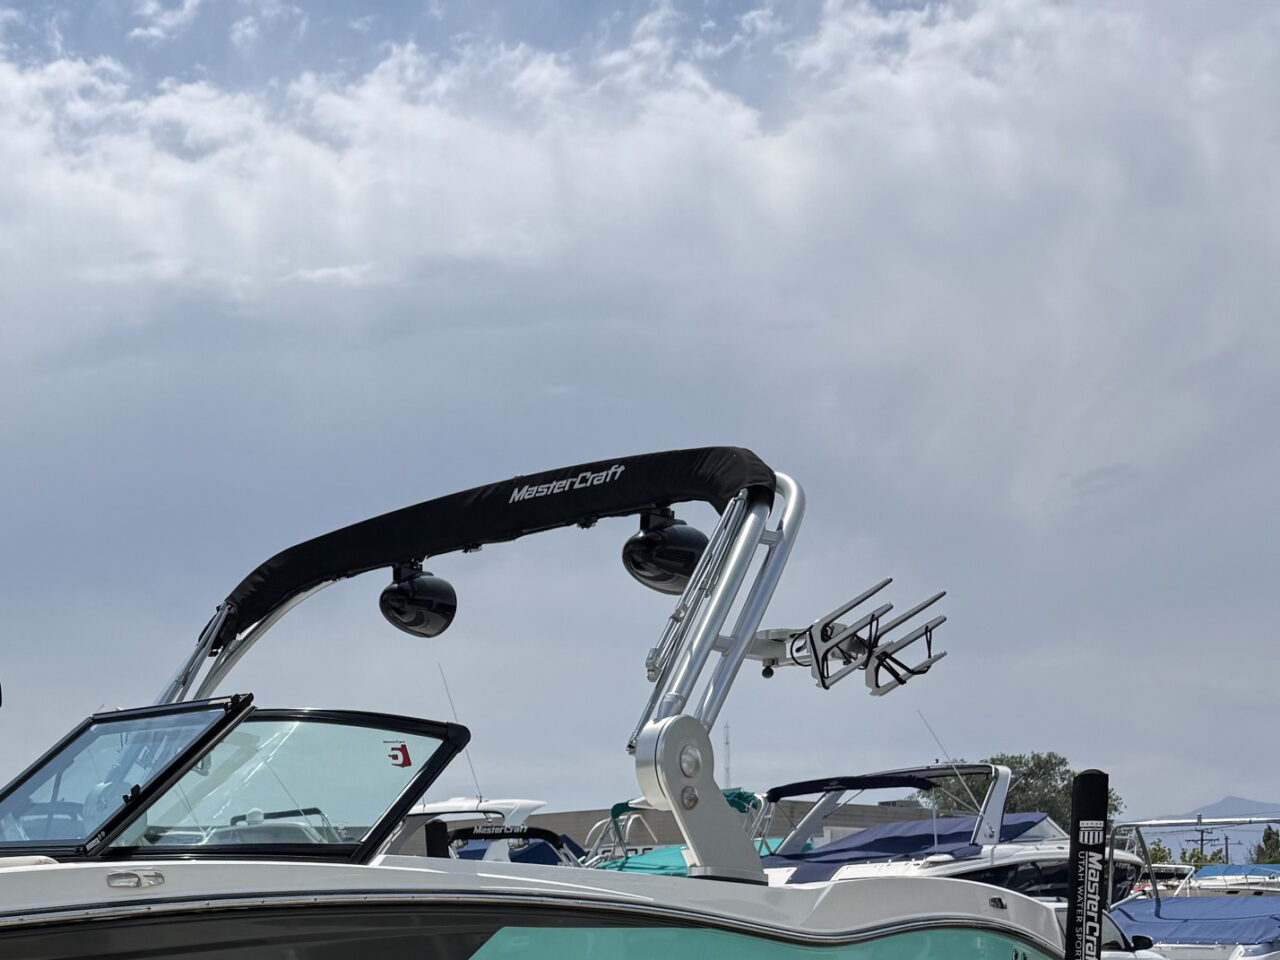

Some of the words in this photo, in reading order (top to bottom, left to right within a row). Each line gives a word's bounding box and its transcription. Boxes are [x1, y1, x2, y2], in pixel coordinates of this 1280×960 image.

[508, 464, 626, 504] MasterCraft
[472, 824, 528, 835] MasterCraft
[1077, 850, 1085, 882] UTAH
[1075, 885, 1084, 923] WATER
